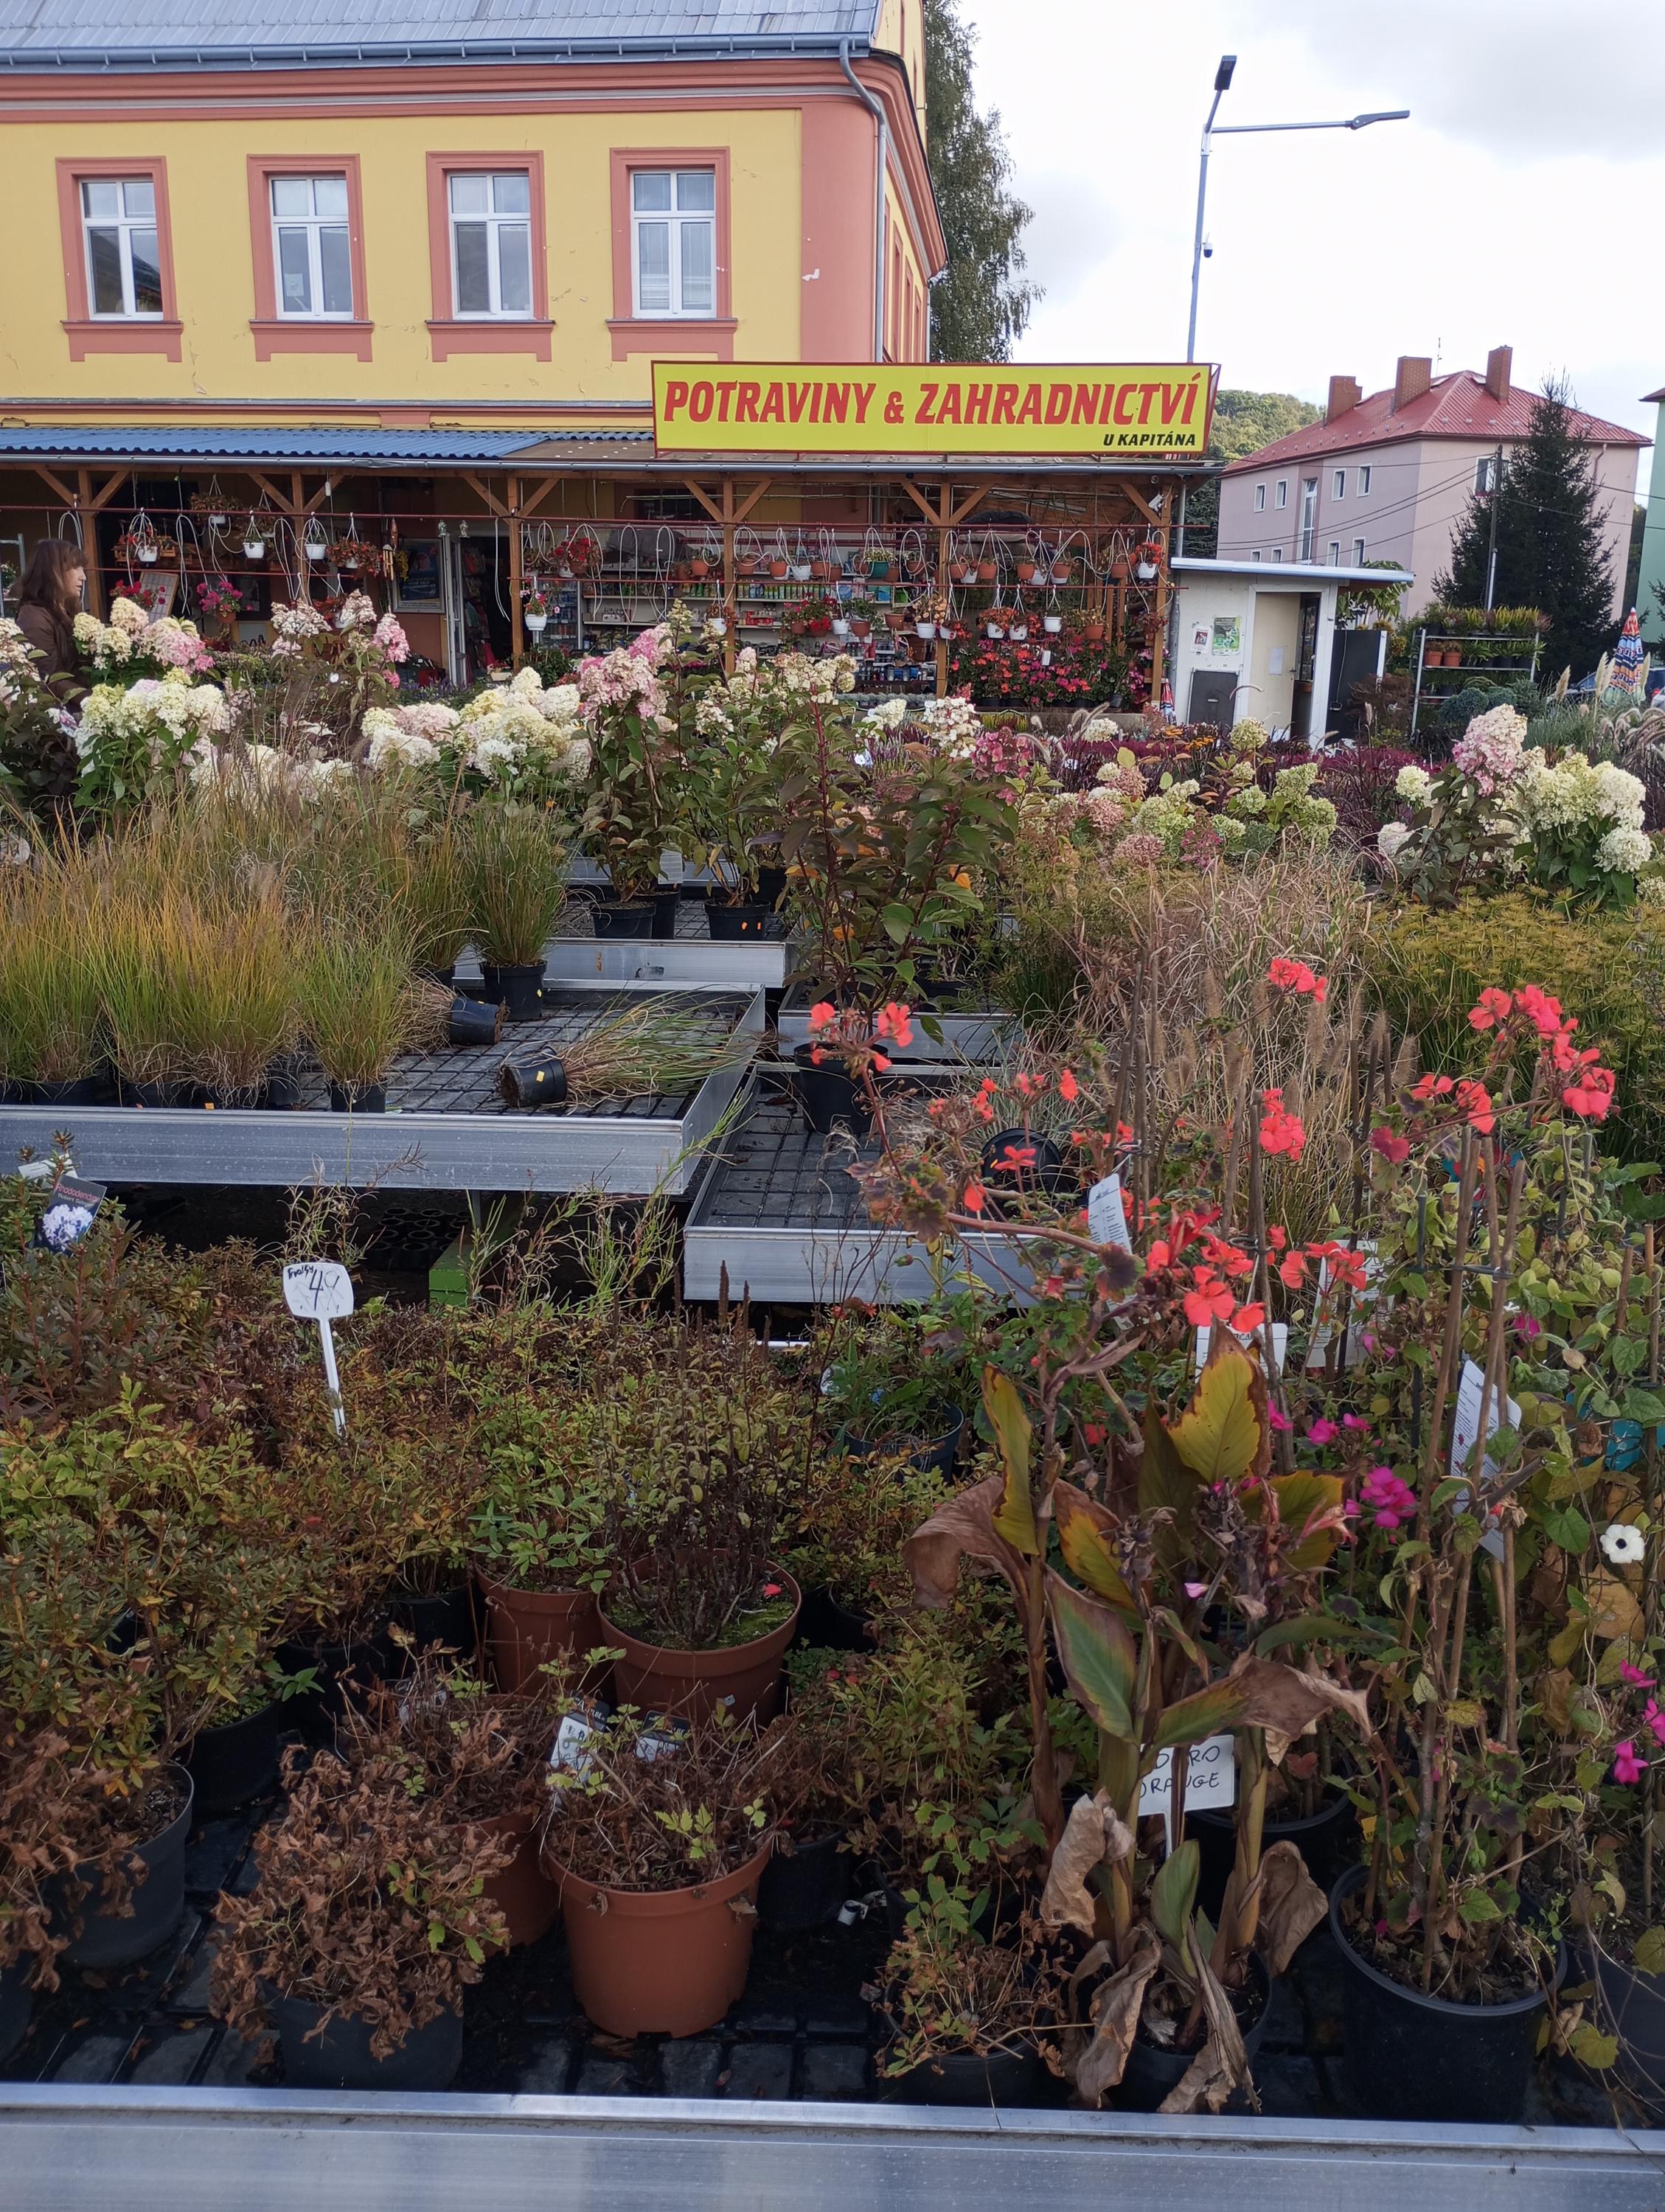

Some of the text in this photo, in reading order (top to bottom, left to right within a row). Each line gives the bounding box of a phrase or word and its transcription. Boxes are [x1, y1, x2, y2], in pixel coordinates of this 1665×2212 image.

[664, 373, 1201, 425] POTRAVINY & ZAHRADNICTVÍ
[1103, 431, 1195, 446] U KAPITÁNA
[56, 1183, 101, 1203] Rhododendron
